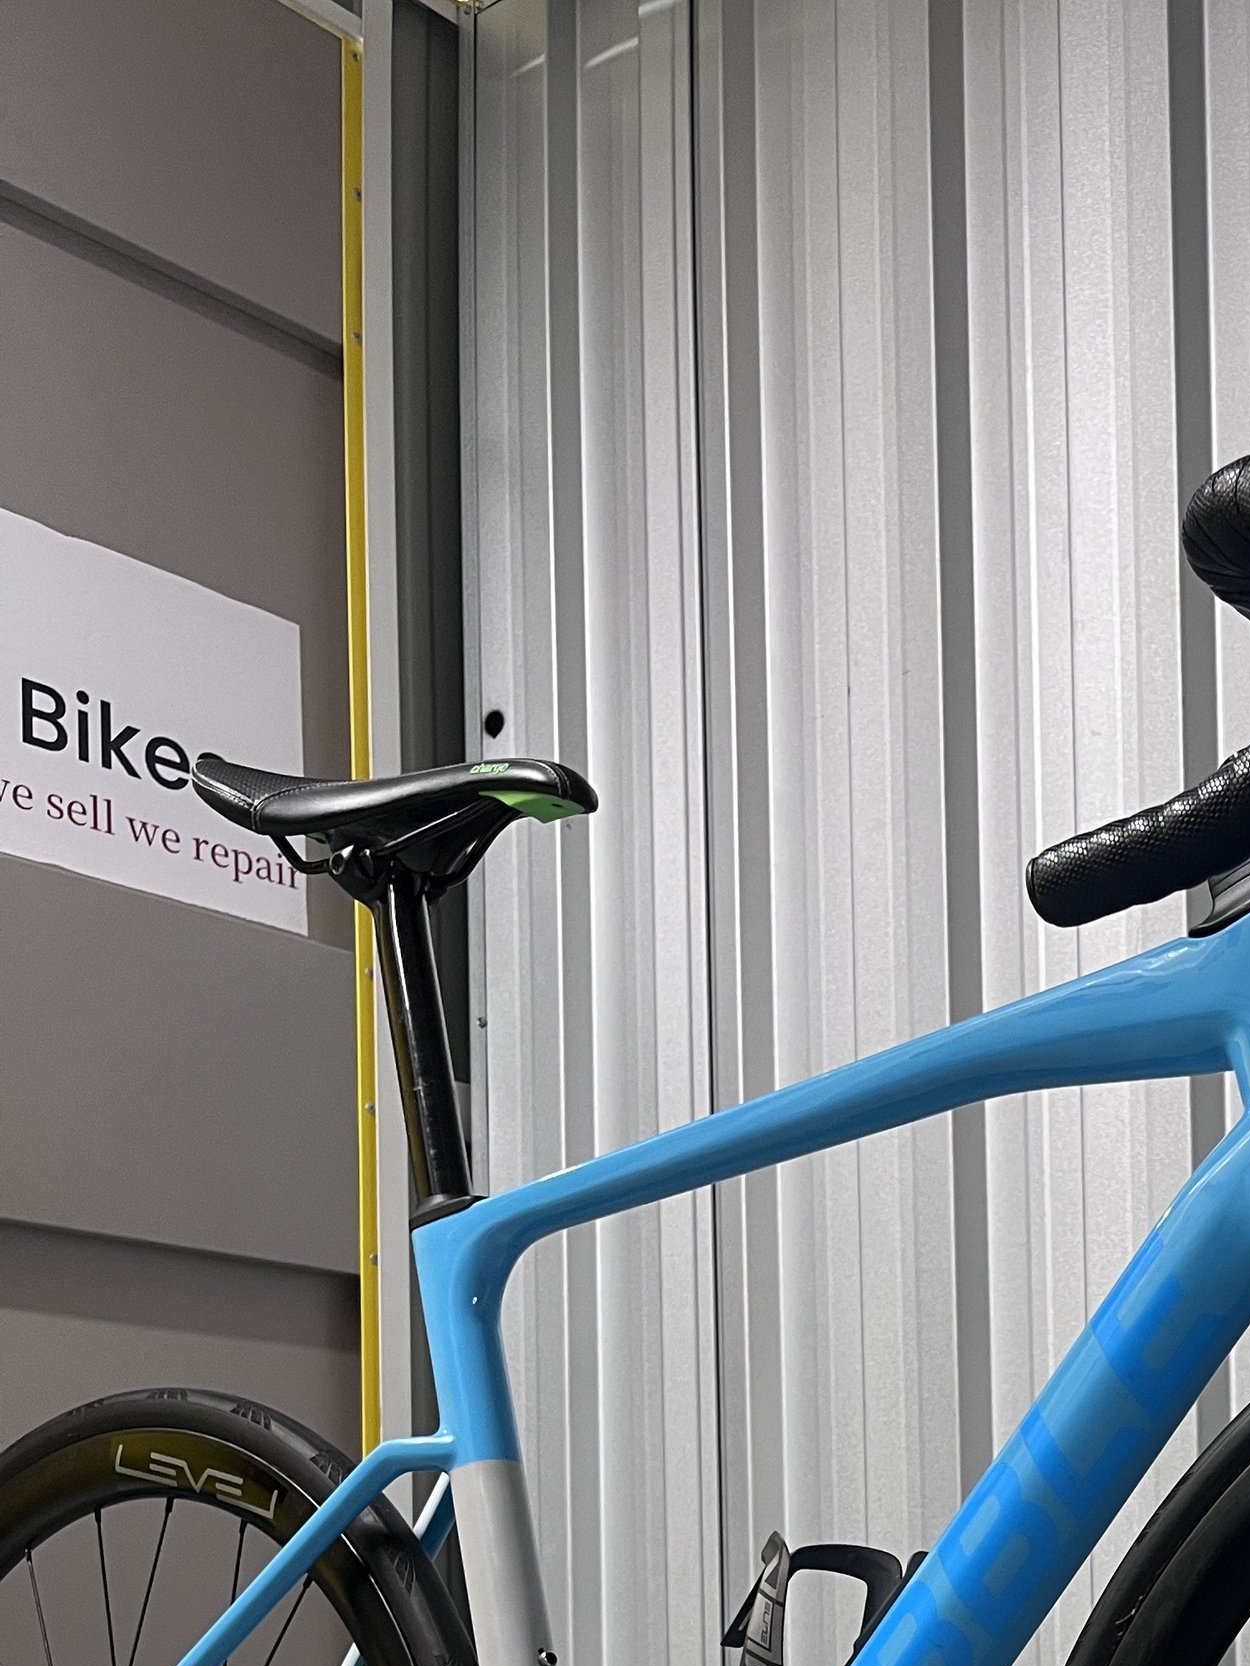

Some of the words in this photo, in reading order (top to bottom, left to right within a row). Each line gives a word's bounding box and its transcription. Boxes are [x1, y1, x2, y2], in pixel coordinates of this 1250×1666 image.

[21, 677, 224, 790] Bike
[46, 794, 116, 836] sell
[125, 816, 181, 854] we
[192, 836, 300, 890] repair
